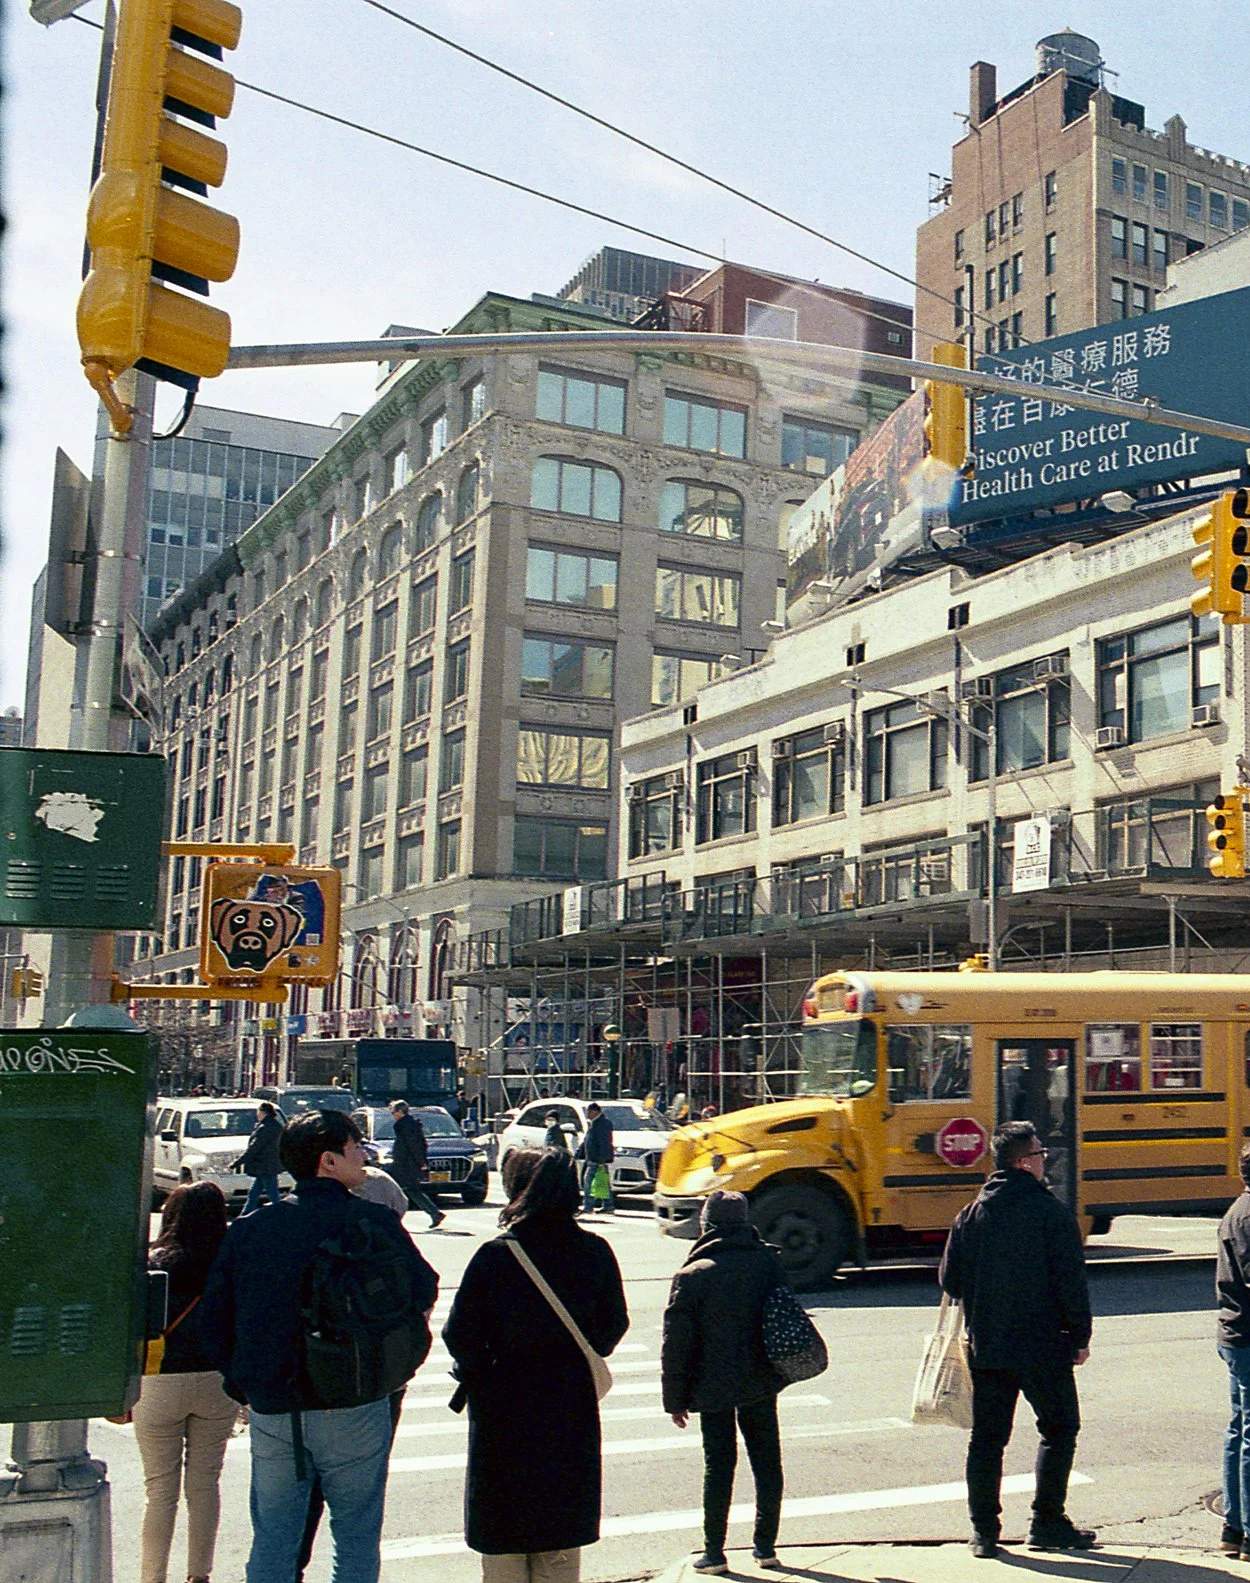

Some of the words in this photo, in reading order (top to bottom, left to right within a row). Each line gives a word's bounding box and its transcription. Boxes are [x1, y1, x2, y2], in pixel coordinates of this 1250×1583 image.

[975, 323, 1172, 390] 好的醫療服務
[1060, 420, 1131, 453] Better
[961, 469, 1033, 503] Health
[1040, 459, 1091, 486] Care
[1098, 450, 1119, 472] at
[1126, 431, 1200, 467] Rendr
[943, 1133, 981, 1152] STOP
